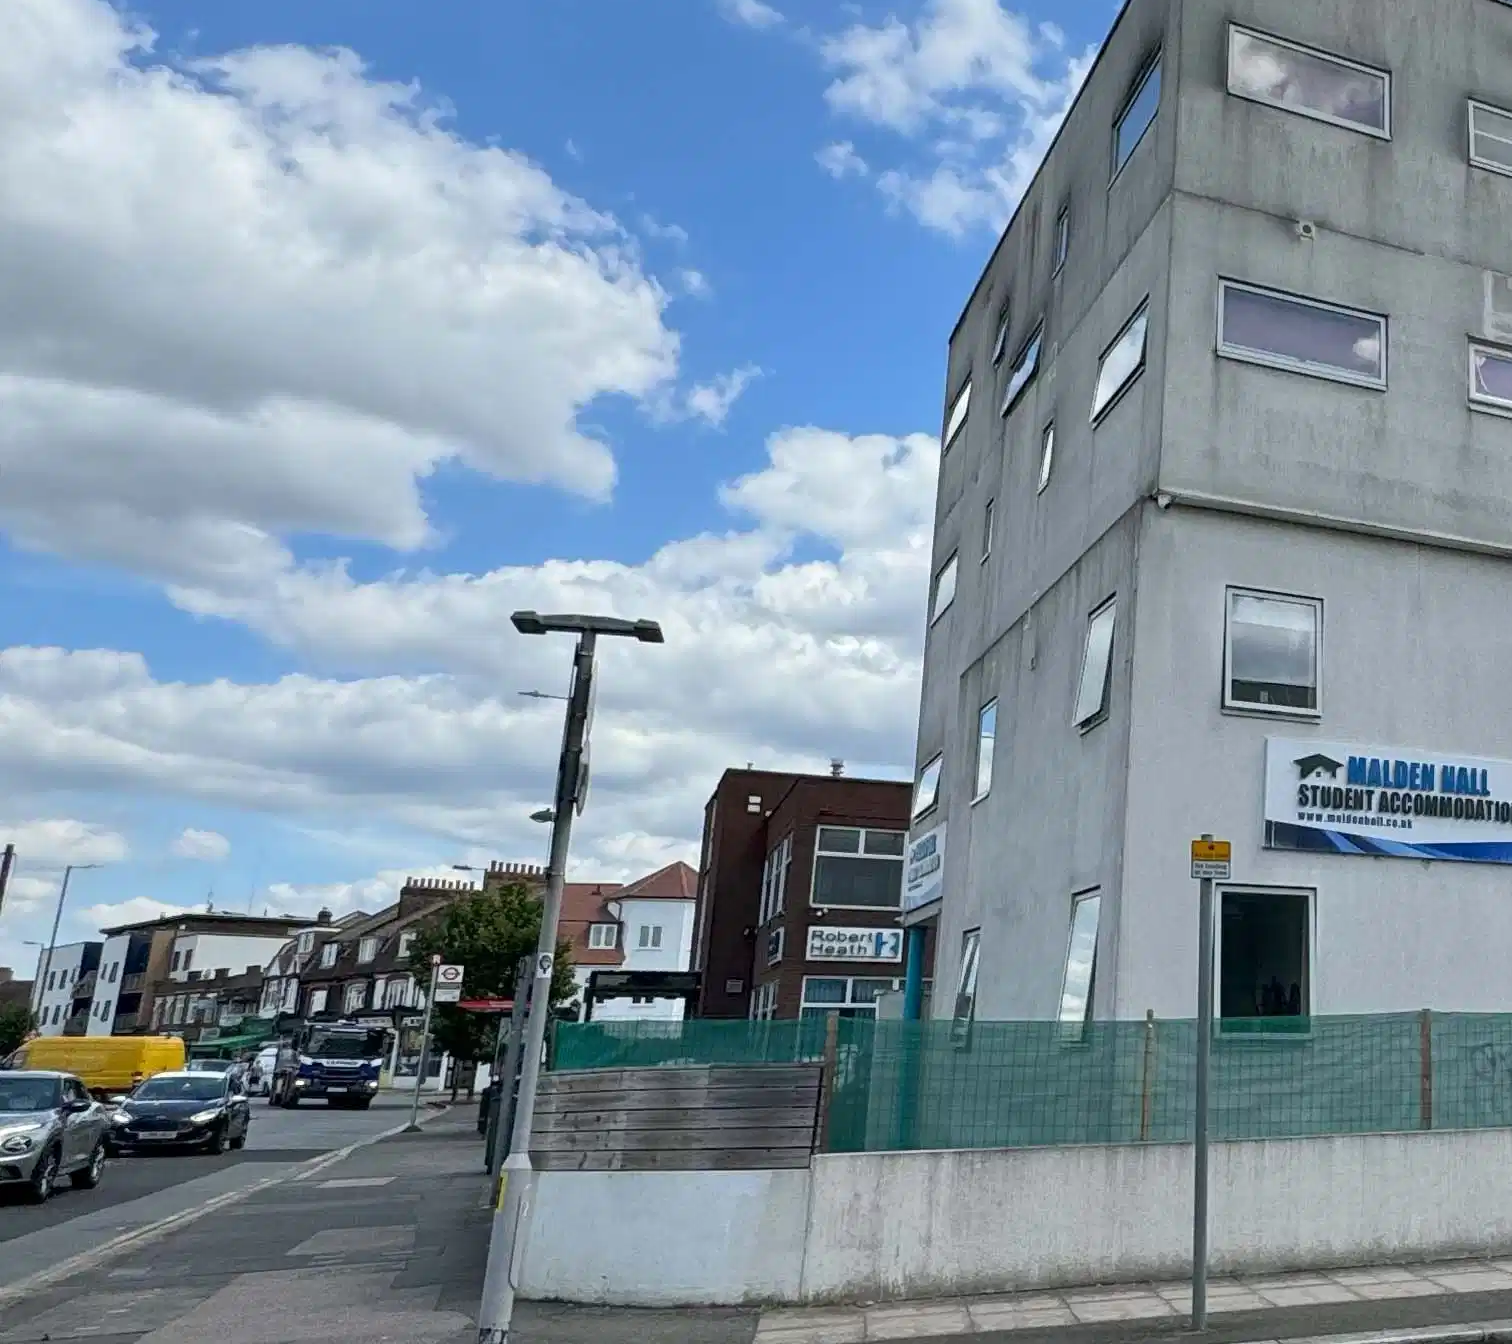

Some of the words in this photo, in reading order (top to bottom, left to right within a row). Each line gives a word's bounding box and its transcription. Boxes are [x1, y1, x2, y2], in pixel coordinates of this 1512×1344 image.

[1348, 756, 1436, 791] MALDEN
[1441, 764, 1491, 796] HALL
[1298, 784, 1375, 810] STUDENT
[812, 930, 873, 943] Robert
[810, 943, 868, 955] Heath
